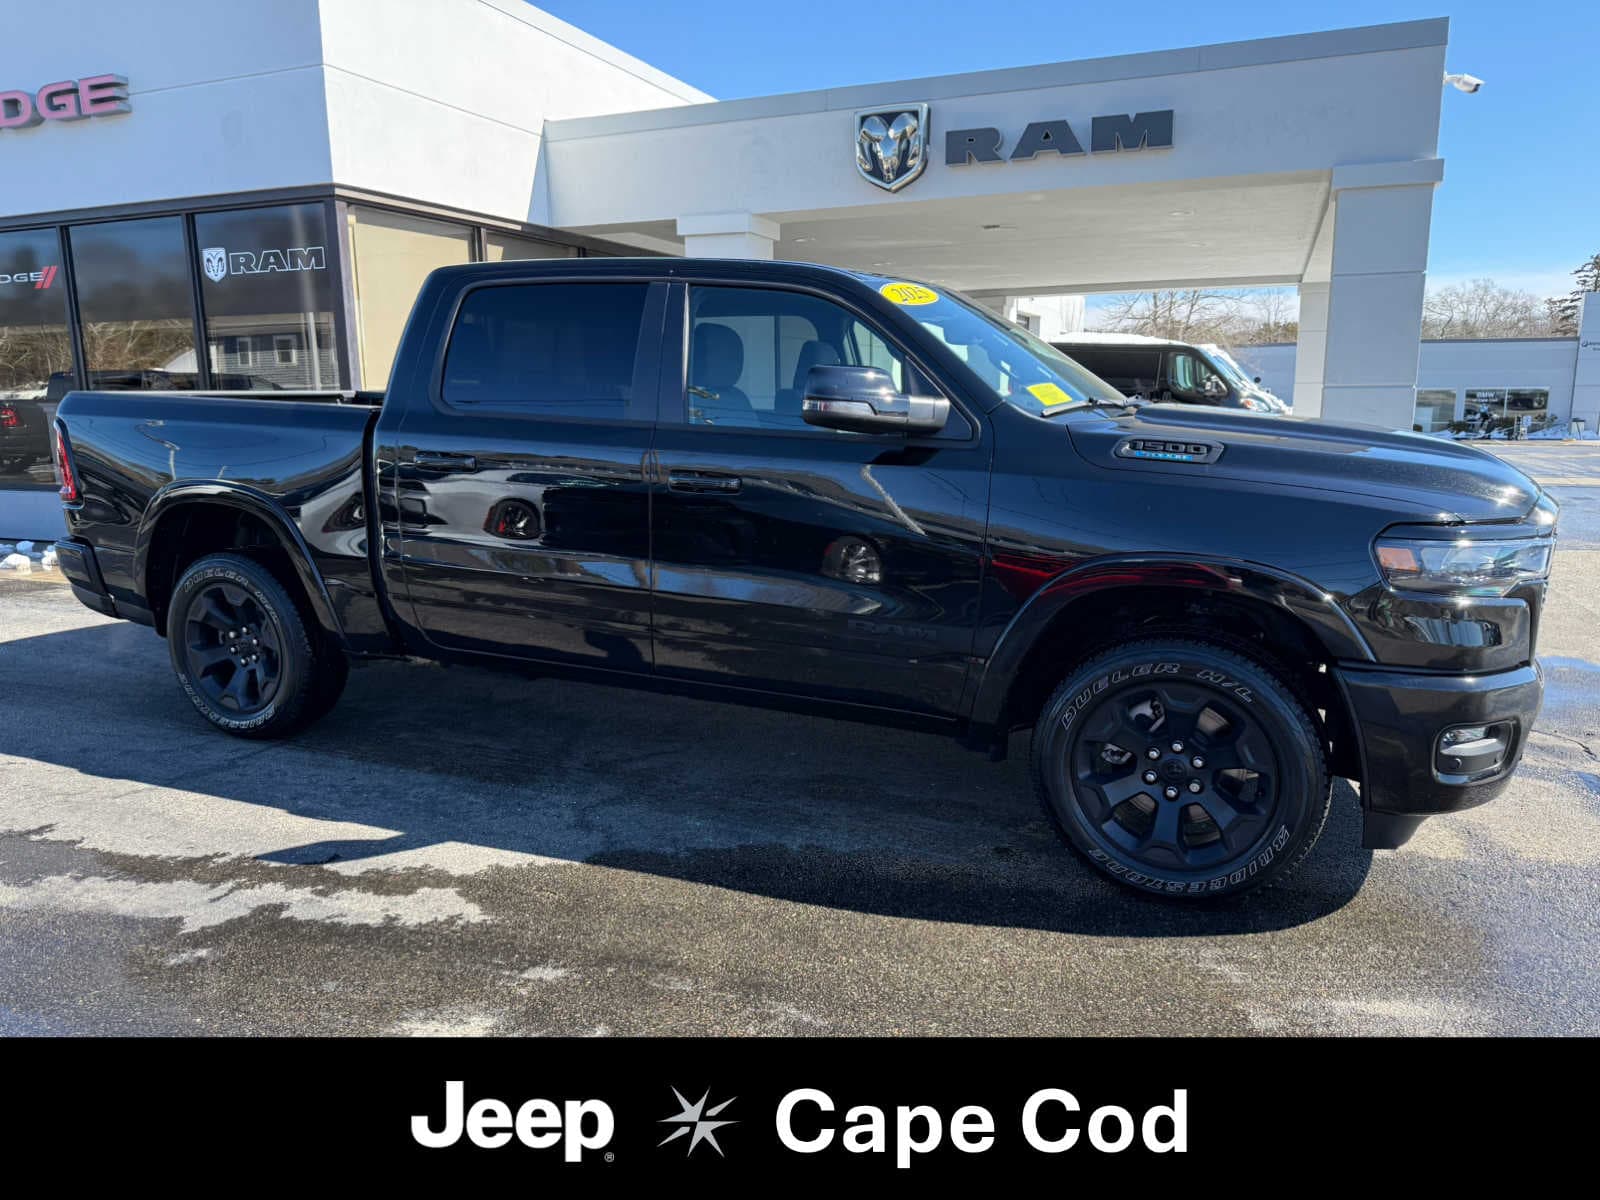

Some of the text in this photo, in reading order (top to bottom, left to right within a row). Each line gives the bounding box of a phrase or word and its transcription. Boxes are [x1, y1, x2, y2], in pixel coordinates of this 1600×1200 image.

[945, 109, 1175, 166] RAM
[229, 246, 326, 275] RAM
[1133, 440, 1208, 455] 1500
[1061, 662, 1181, 730] DUELER
[1088, 824, 1290, 893] BRIDGESTONE
